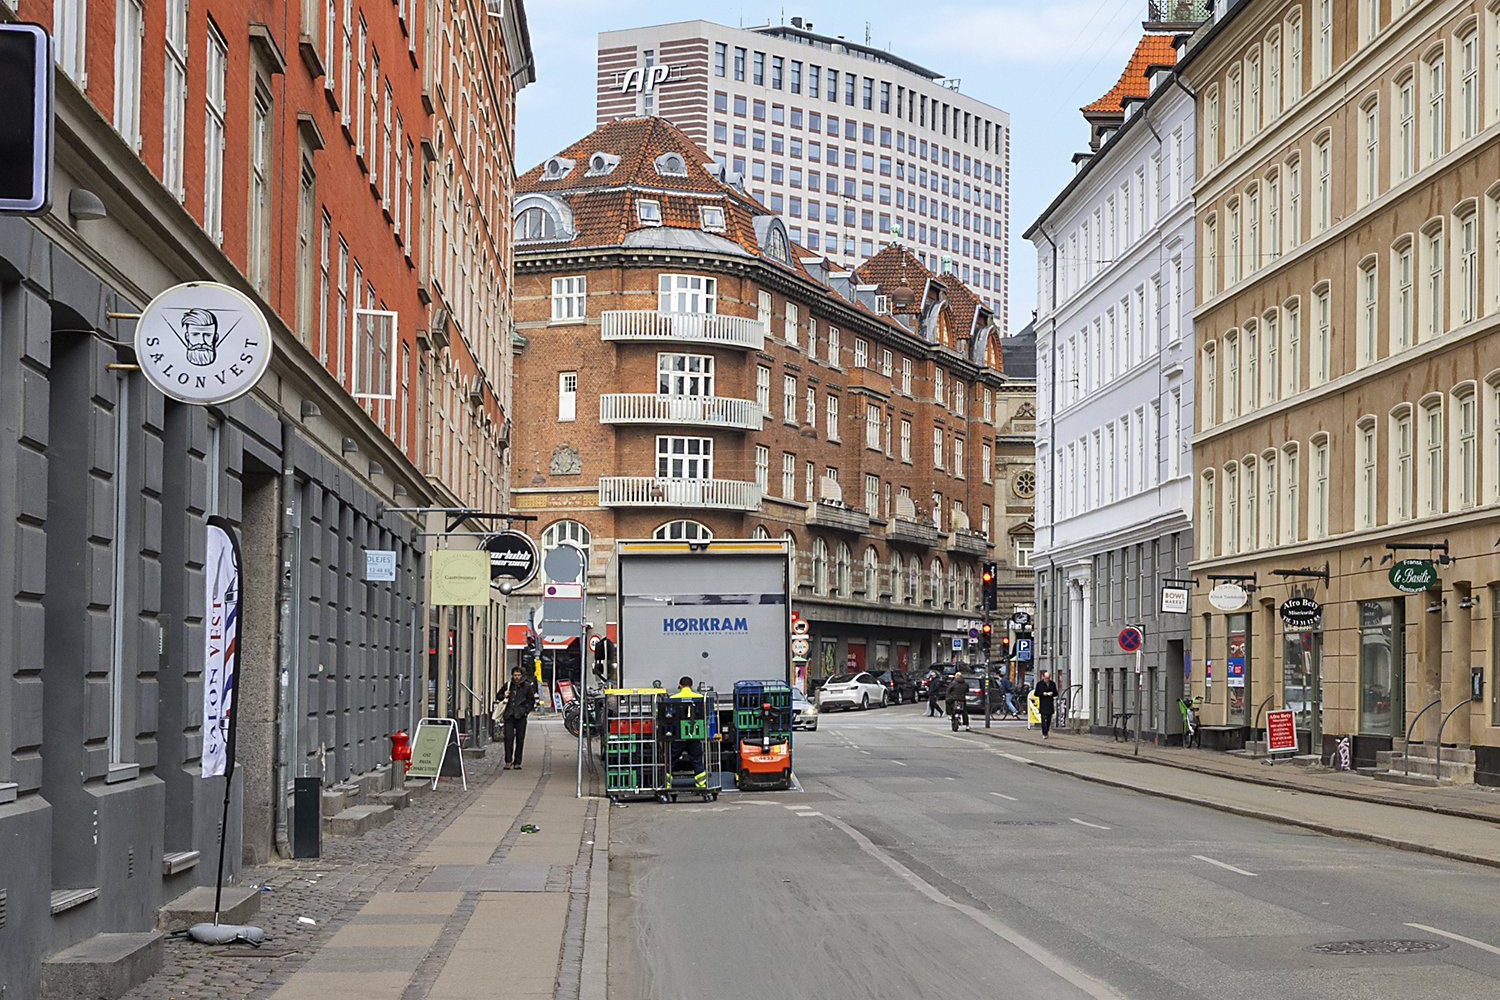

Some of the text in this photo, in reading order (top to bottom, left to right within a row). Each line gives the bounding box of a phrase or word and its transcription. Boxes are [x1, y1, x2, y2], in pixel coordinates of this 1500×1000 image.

[146, 337, 258, 388] SALON VEST
[1402, 567, 1431, 583] Basilic
[1283, 598, 1318, 610] Afro Bety
[663, 617, 748, 632] HØRKRAM
[1020, 641, 1028, 651] P
[207, 598, 222, 754] SALON VEST
